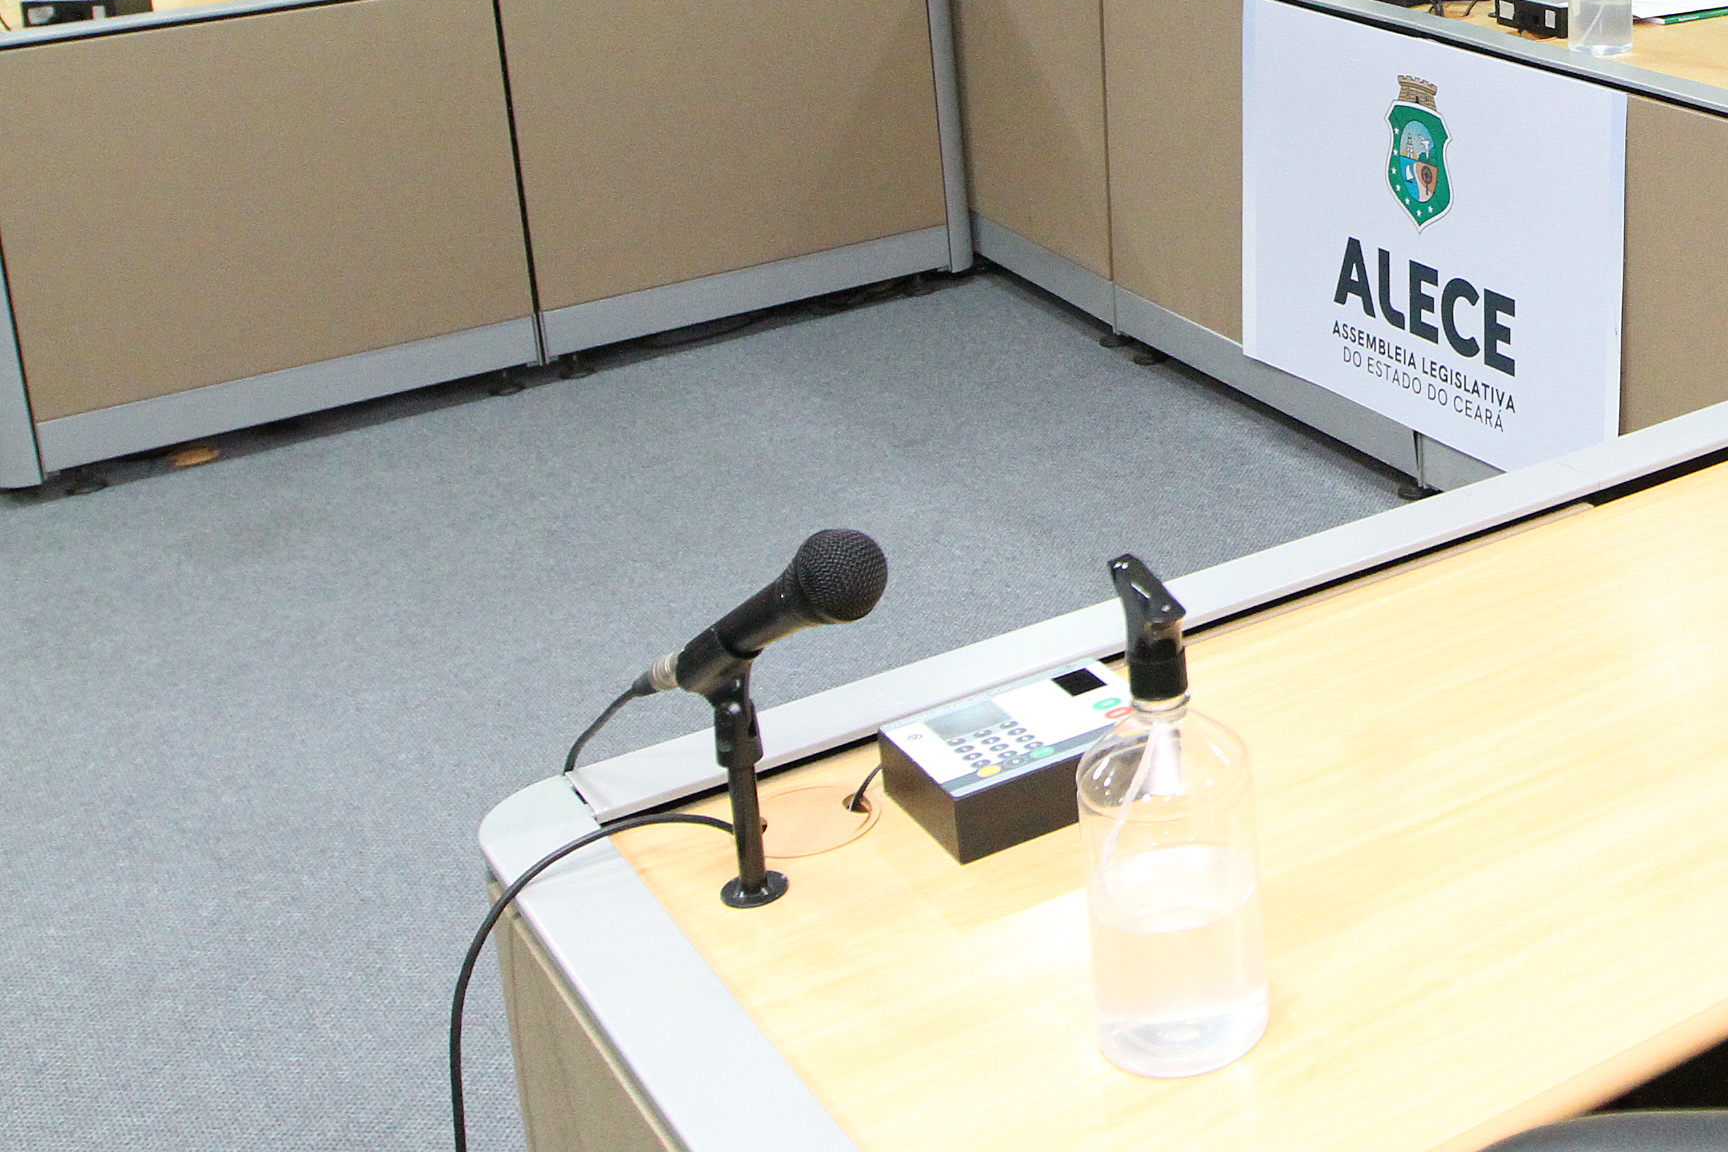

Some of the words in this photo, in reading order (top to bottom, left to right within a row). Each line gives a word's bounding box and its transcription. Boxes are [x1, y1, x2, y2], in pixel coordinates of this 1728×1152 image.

[1333, 236, 1516, 378] ALECE
[1332, 319, 1417, 370] ASSEMBLEIA
[1421, 357, 1516, 415] LEGISLATIVA
[1343, 345, 1362, 368] DO
[1367, 356, 1422, 395] ESTADO
[1427, 383, 1448, 406] DO
[1453, 395, 1504, 433] CEARÁ
